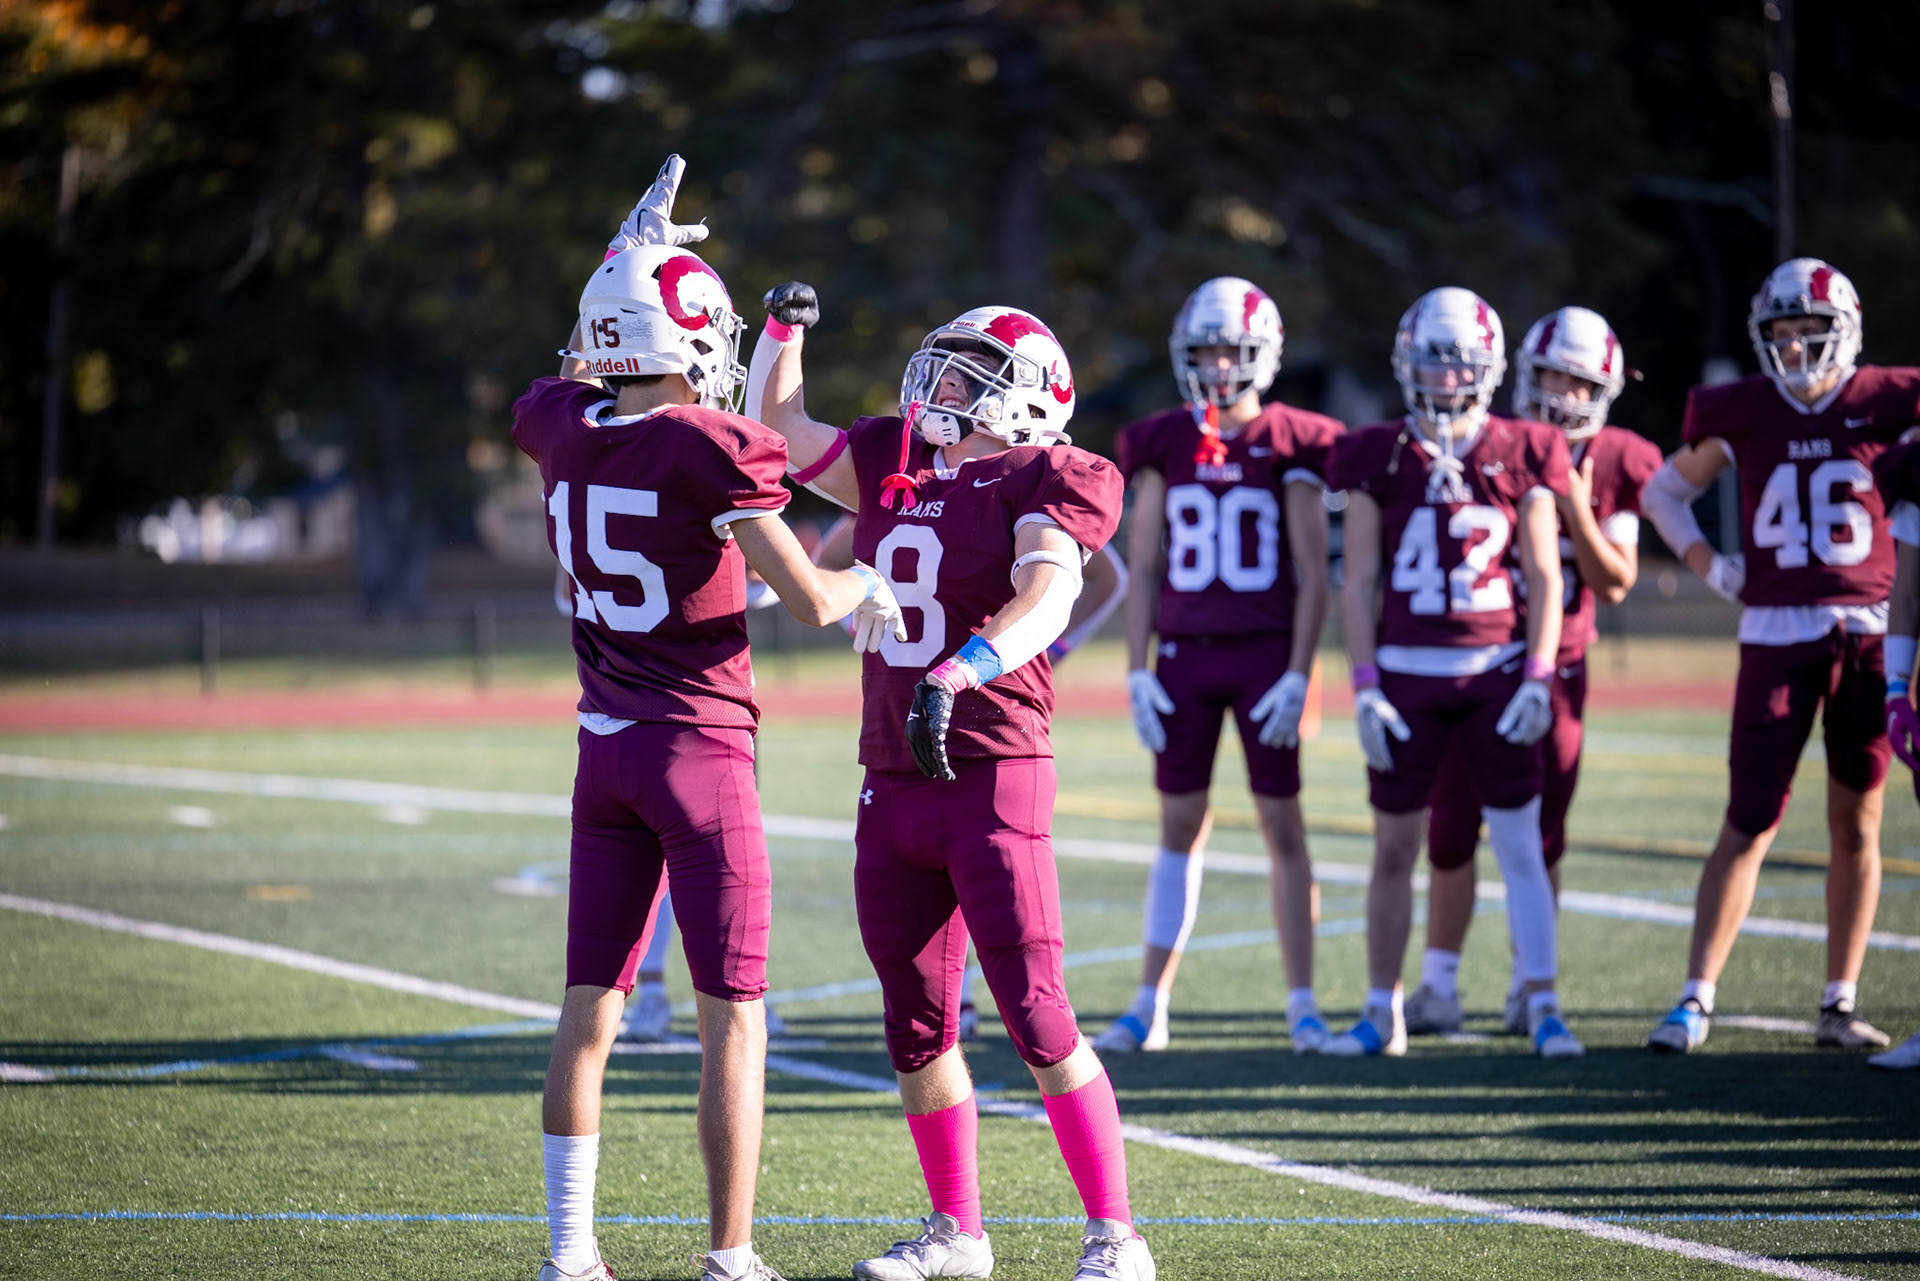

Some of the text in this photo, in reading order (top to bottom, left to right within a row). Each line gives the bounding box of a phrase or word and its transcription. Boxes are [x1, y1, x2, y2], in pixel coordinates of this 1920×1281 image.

[586, 358, 640, 375] Riddell
[590, 317, 620, 349] 15
[1788, 439, 1832, 459] RAMS
[548, 481, 669, 633] 15
[1166, 484, 1279, 592] 80
[1391, 505, 1512, 615] 42
[1753, 460, 1873, 568] 46
[875, 524, 946, 668] 8
